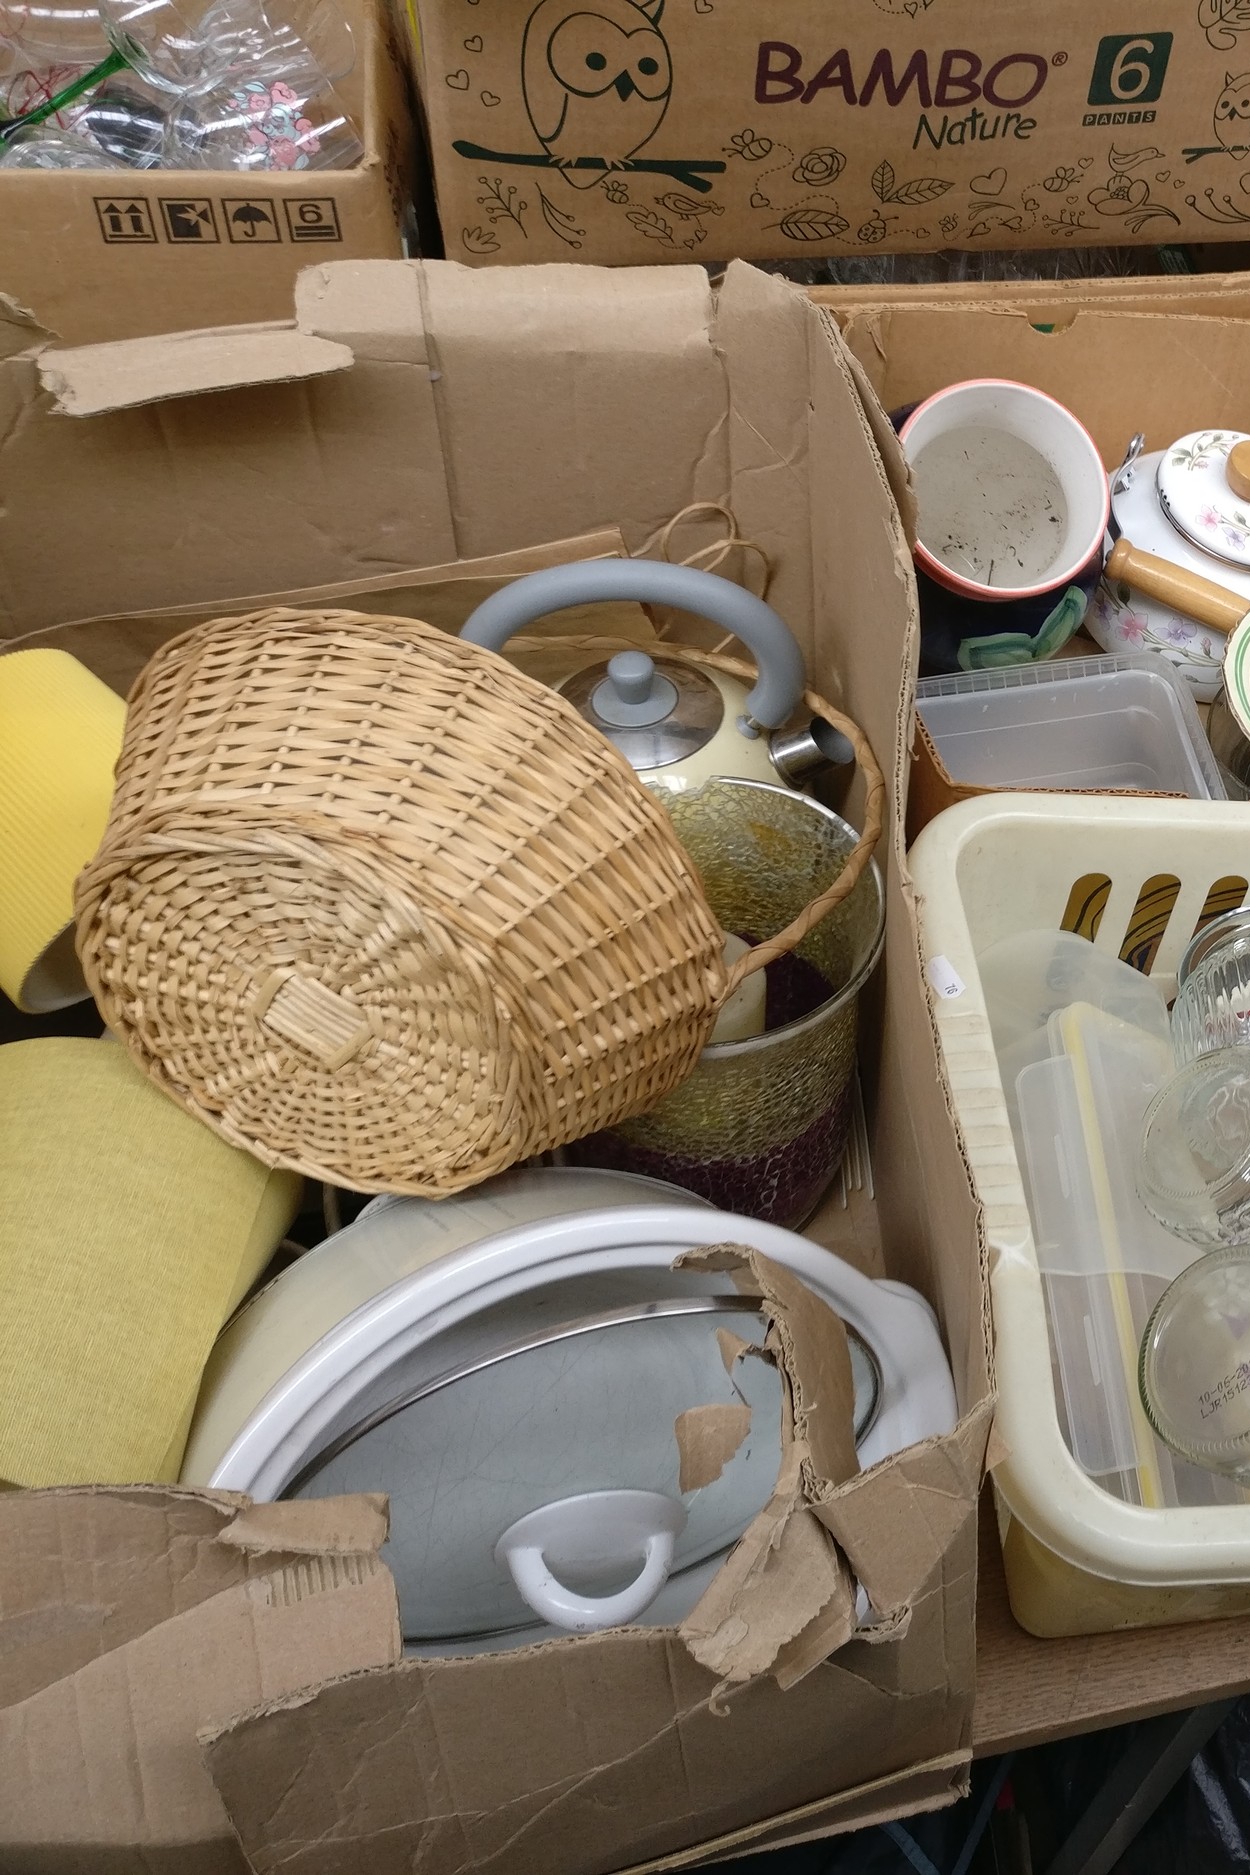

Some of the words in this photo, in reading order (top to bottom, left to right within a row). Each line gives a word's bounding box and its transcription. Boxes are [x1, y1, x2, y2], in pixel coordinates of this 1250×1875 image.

[1110, 39, 1155, 100] 6
[912, 107, 1038, 150] Nature
[1084, 112, 1156, 125] PANTS
[299, 203, 323, 224] 6
[944, 982, 958, 995] 76
